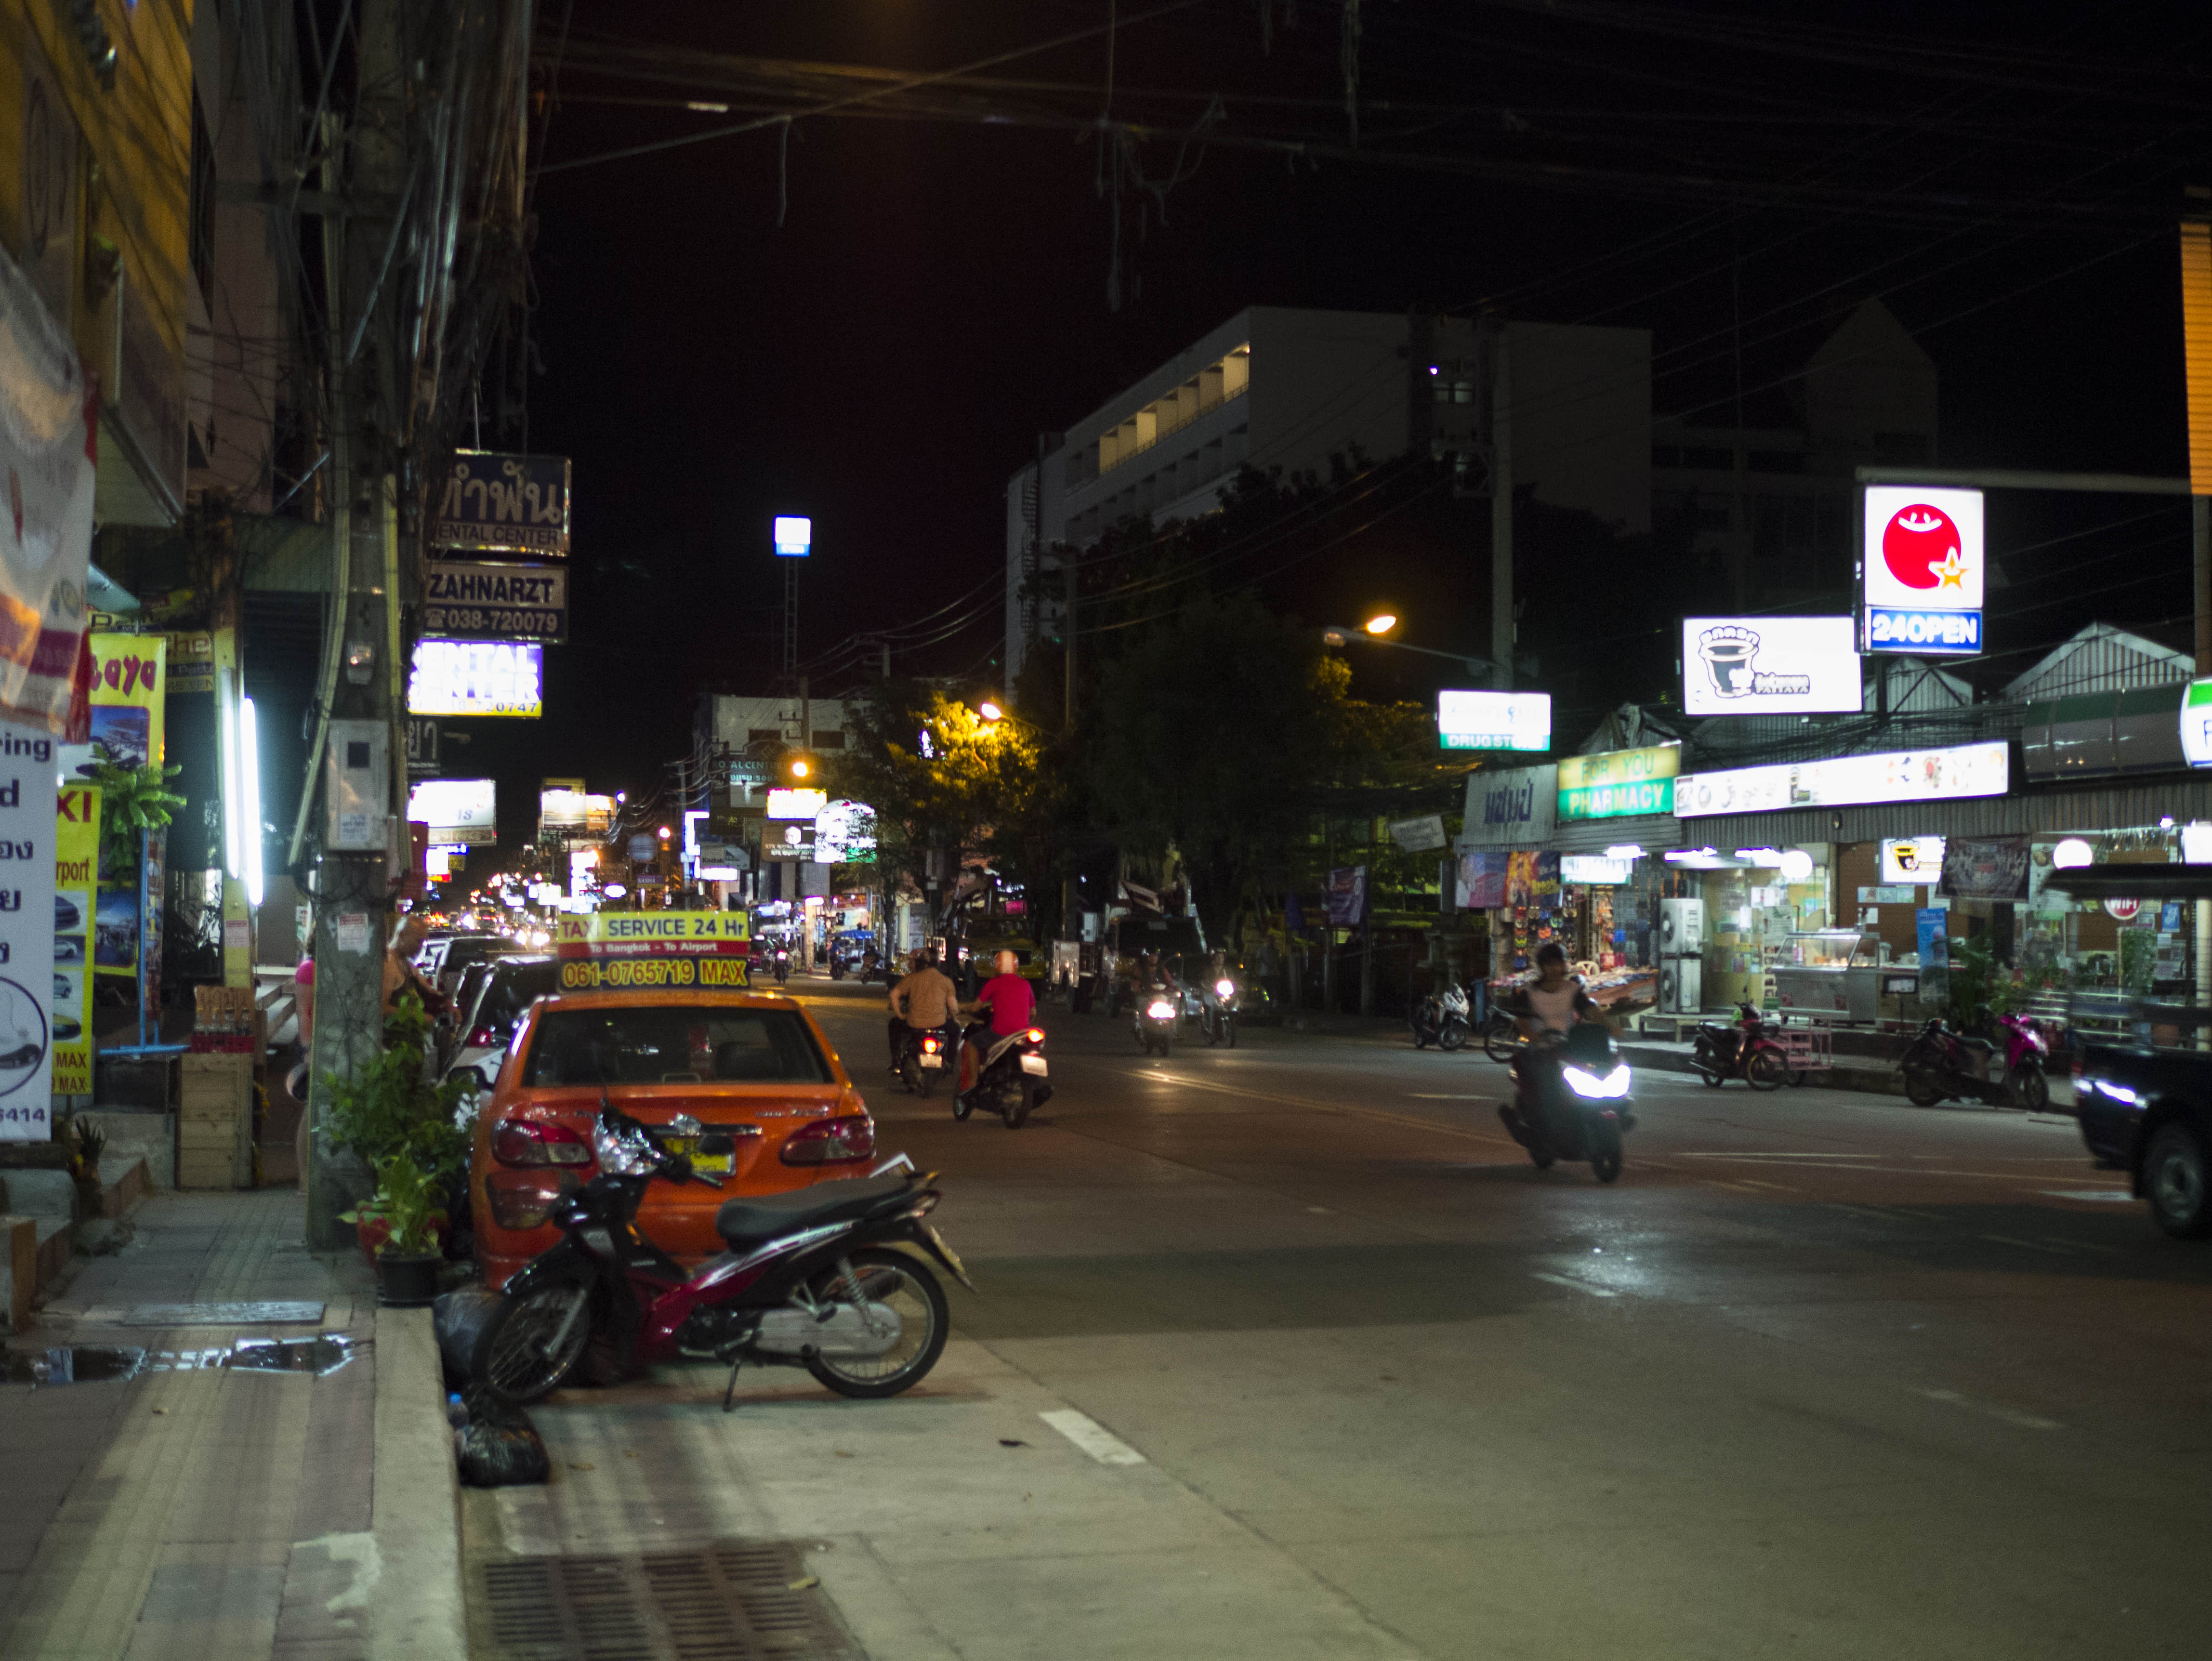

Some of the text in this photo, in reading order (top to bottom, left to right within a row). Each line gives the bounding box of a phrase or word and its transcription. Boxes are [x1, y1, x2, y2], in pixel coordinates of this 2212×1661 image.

[437, 526, 558, 545] ENTAL CENTER
[429, 574, 554, 603] ZAHNARZT
[448, 608, 557, 633] 038-720079
[0, 732, 51, 762] ing
[1581, 753, 1654, 781] FOR YOU
[1569, 783, 1664, 815] PHARMACY
[561, 919, 745, 938] TAXI SERVICE 24 Hr
[606, 942, 650, 954] Bangkok
[664, 943, 677, 952] To
[680, 942, 718, 953] Airport
[563, 959, 749, 987] 061-0765719 MAX
[56, 1052, 87, 1068] MAX
[59, 1077, 86, 1092] MAX
[0, 1107, 46, 1122] 414
